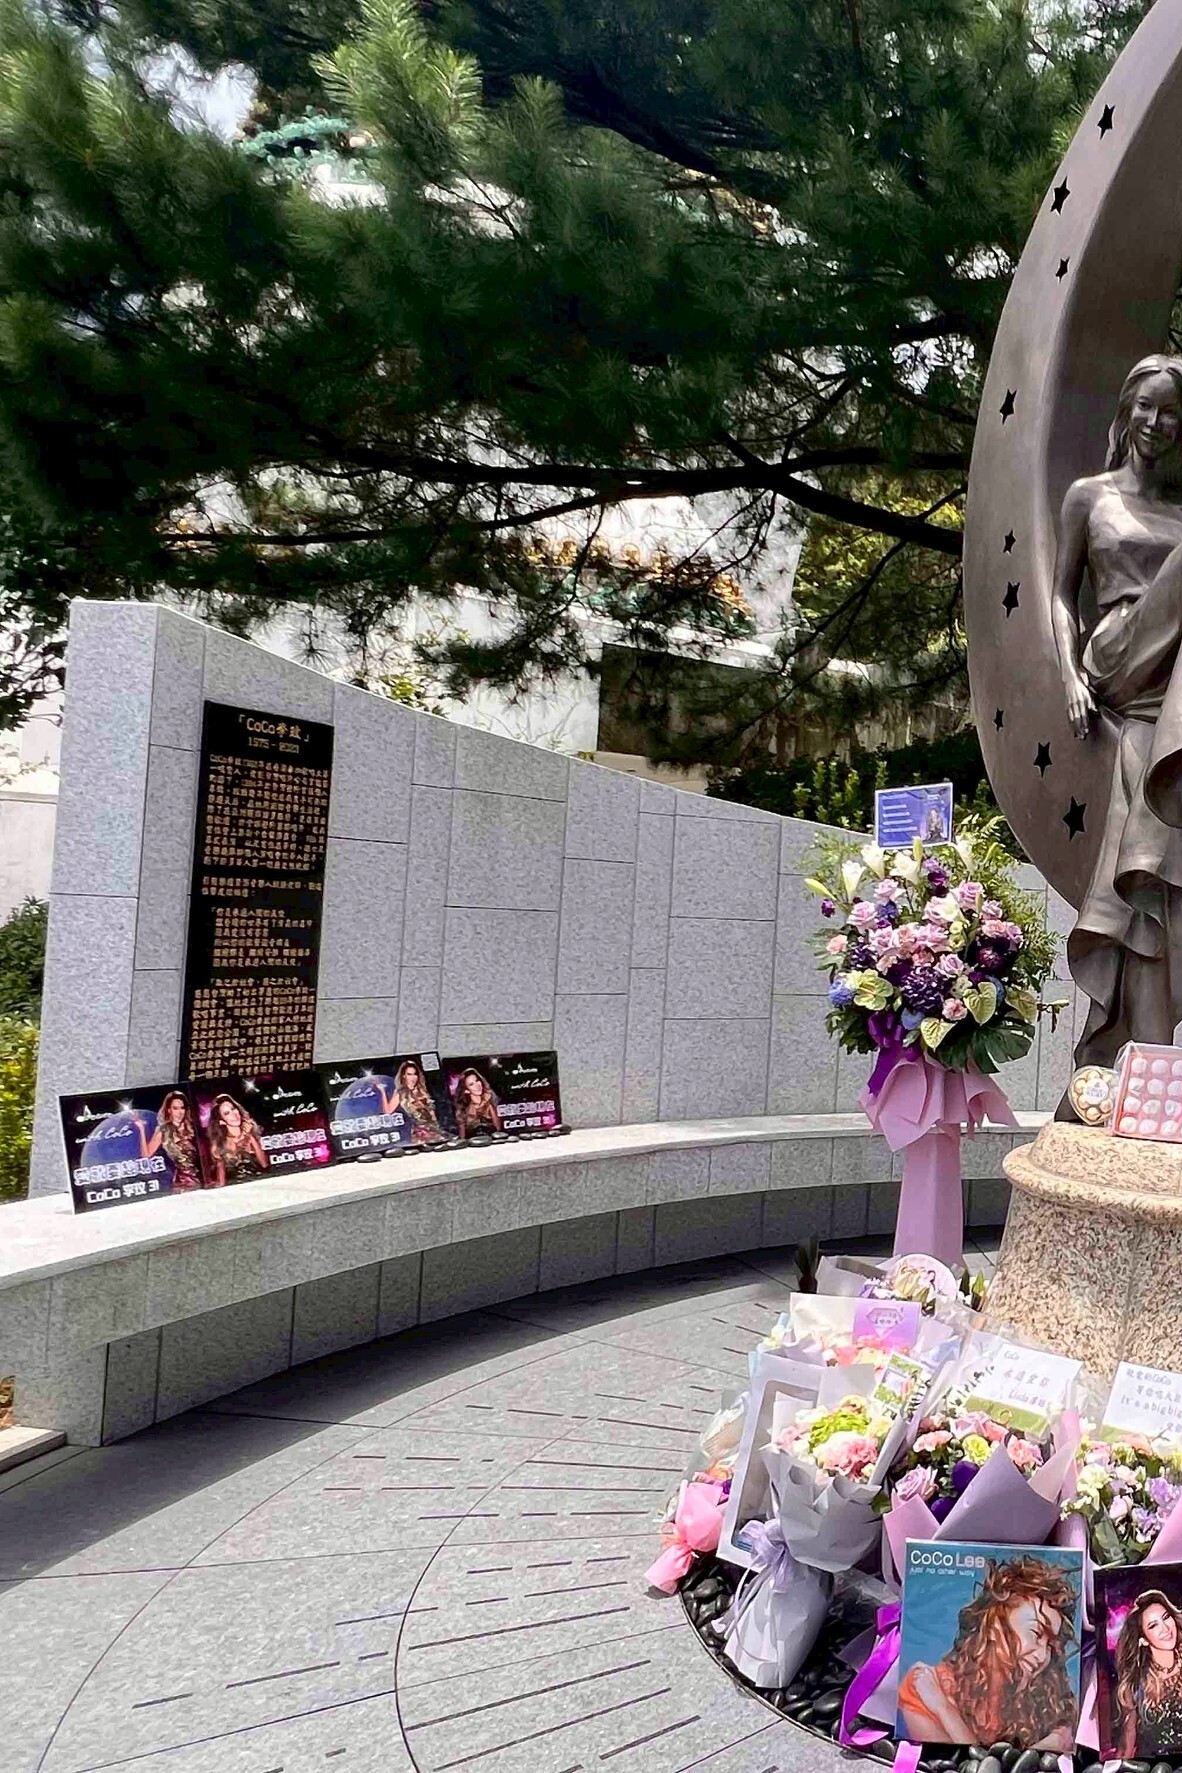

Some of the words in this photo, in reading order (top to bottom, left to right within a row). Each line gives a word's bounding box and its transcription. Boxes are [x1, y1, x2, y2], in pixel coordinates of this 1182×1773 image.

[86, 1188, 121, 1204] CoCo
[910, 1550, 953, 1566] CoCo
[955, 1552, 986, 1568] Lee
